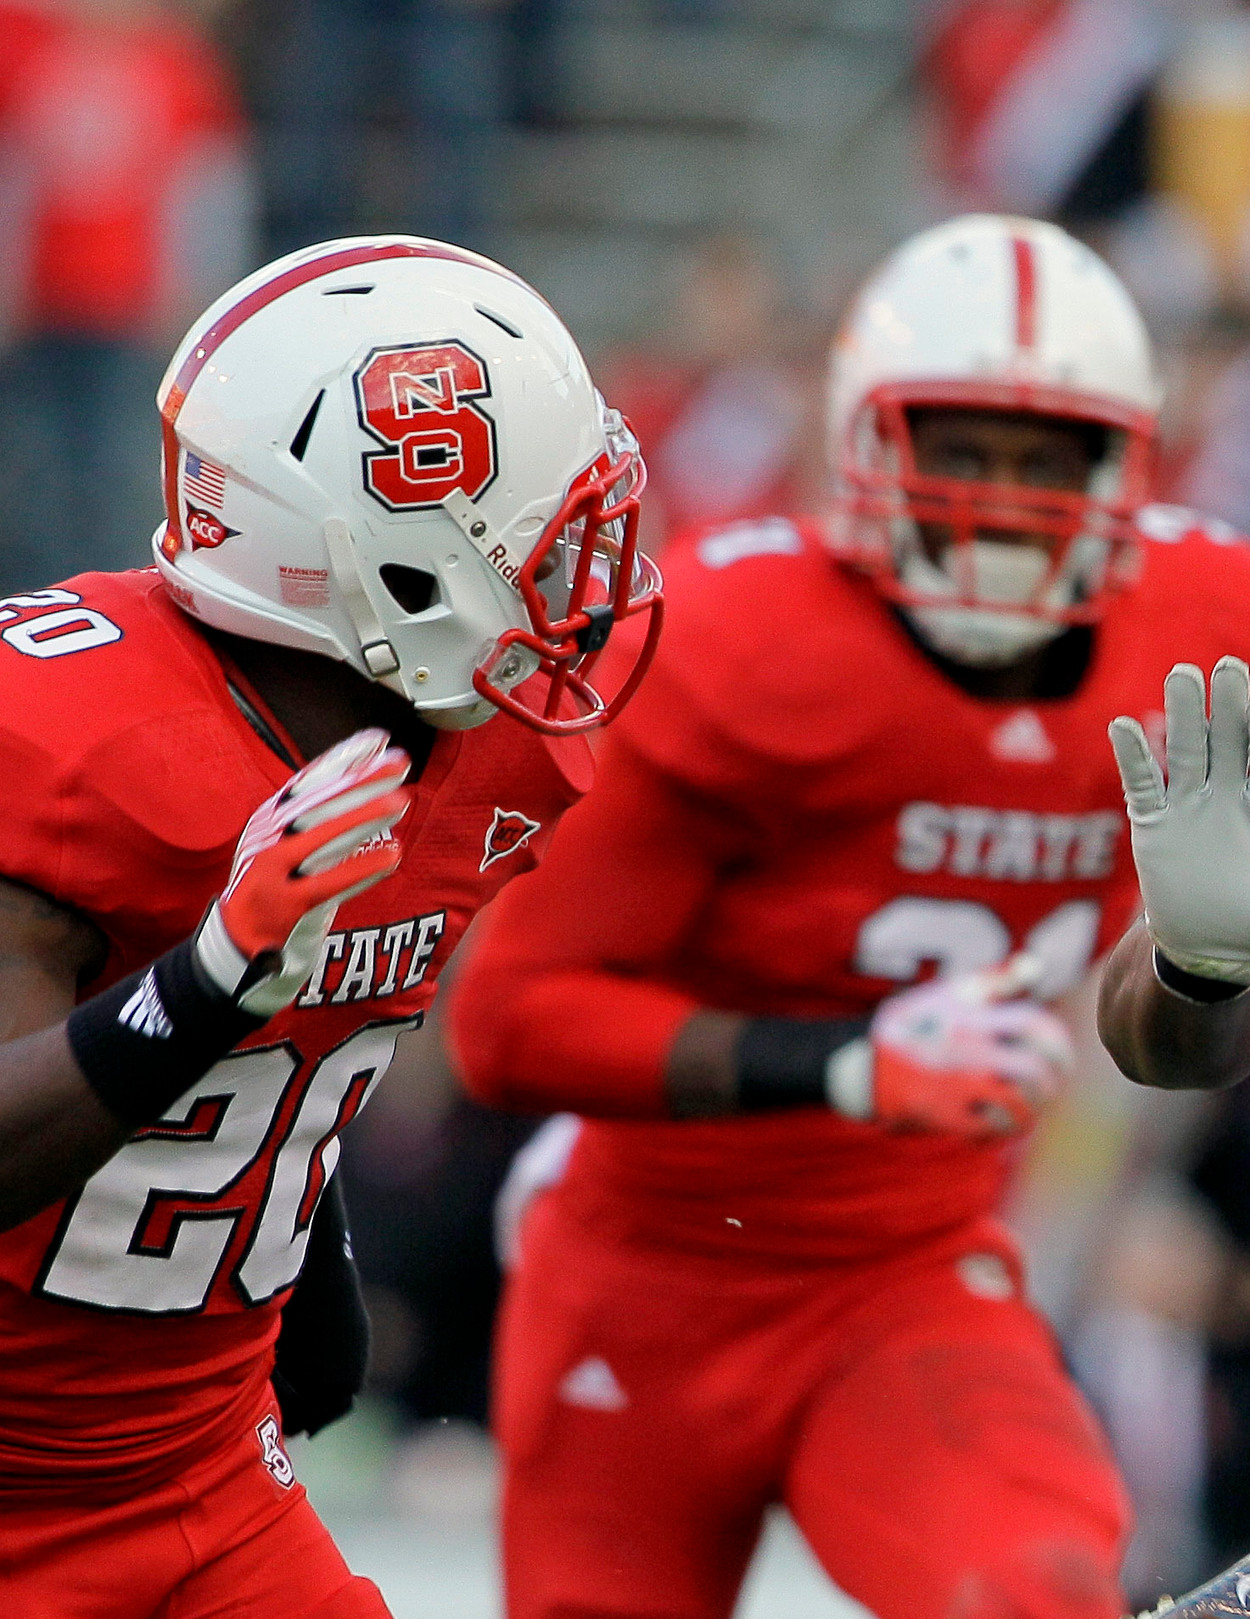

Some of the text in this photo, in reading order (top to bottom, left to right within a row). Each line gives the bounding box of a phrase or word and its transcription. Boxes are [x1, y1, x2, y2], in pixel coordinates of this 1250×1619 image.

[189, 516, 221, 544] ACC
[279, 566, 328, 577] WARNING
[895, 799, 1124, 884] STATE
[295, 907, 449, 1011] TATE
[28, 1008, 425, 1319] 20
